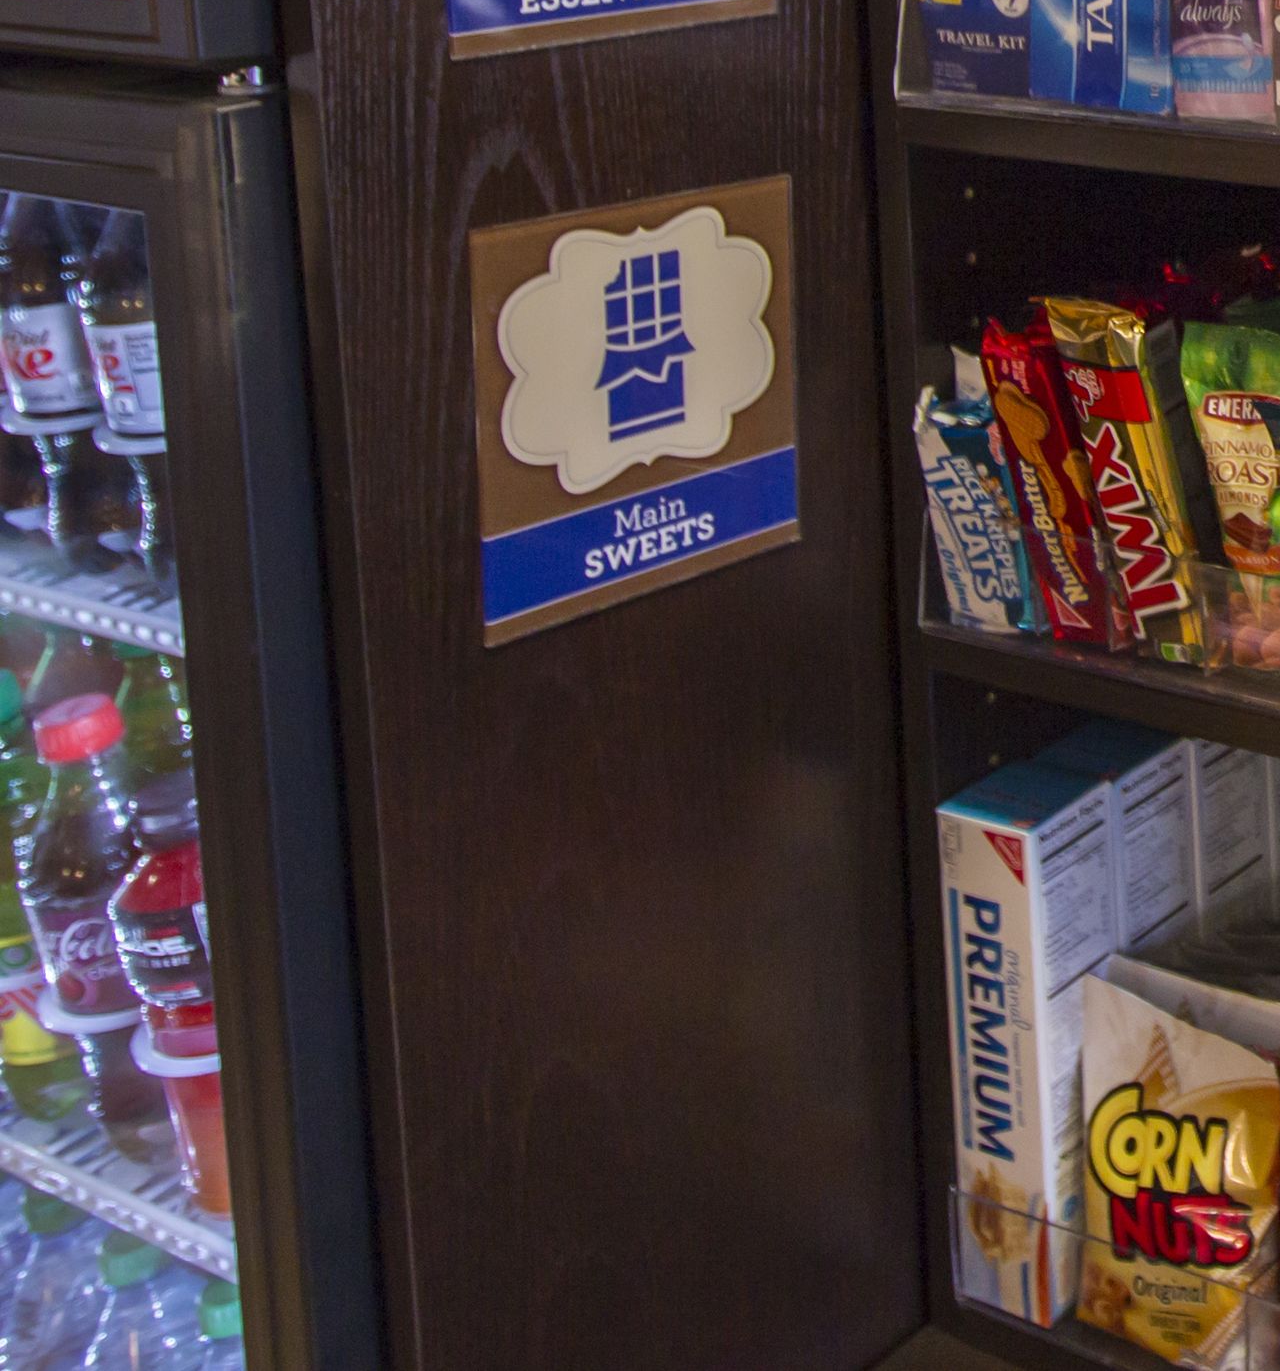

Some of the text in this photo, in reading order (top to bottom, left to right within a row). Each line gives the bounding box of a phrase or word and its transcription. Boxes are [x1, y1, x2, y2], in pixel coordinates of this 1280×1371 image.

[936, 28, 1027, 51] TRAVEL KIT
[584, 512, 716, 579] SWEETS
[613, 495, 687, 538] Main
[925, 457, 1002, 603] TREATS
[950, 455, 1023, 600] RICE KRISPIES
[1019, 458, 1090, 607] Nutter Butter
[1082, 422, 1191, 639] TWIX
[962, 893, 1016, 1164] PREMIUM
[1004, 947, 1033, 1031] original
[1089, 1081, 1228, 1200] CORN
[1110, 1189, 1254, 1268] NUTS
[1132, 1275, 1208, 1305] Original
